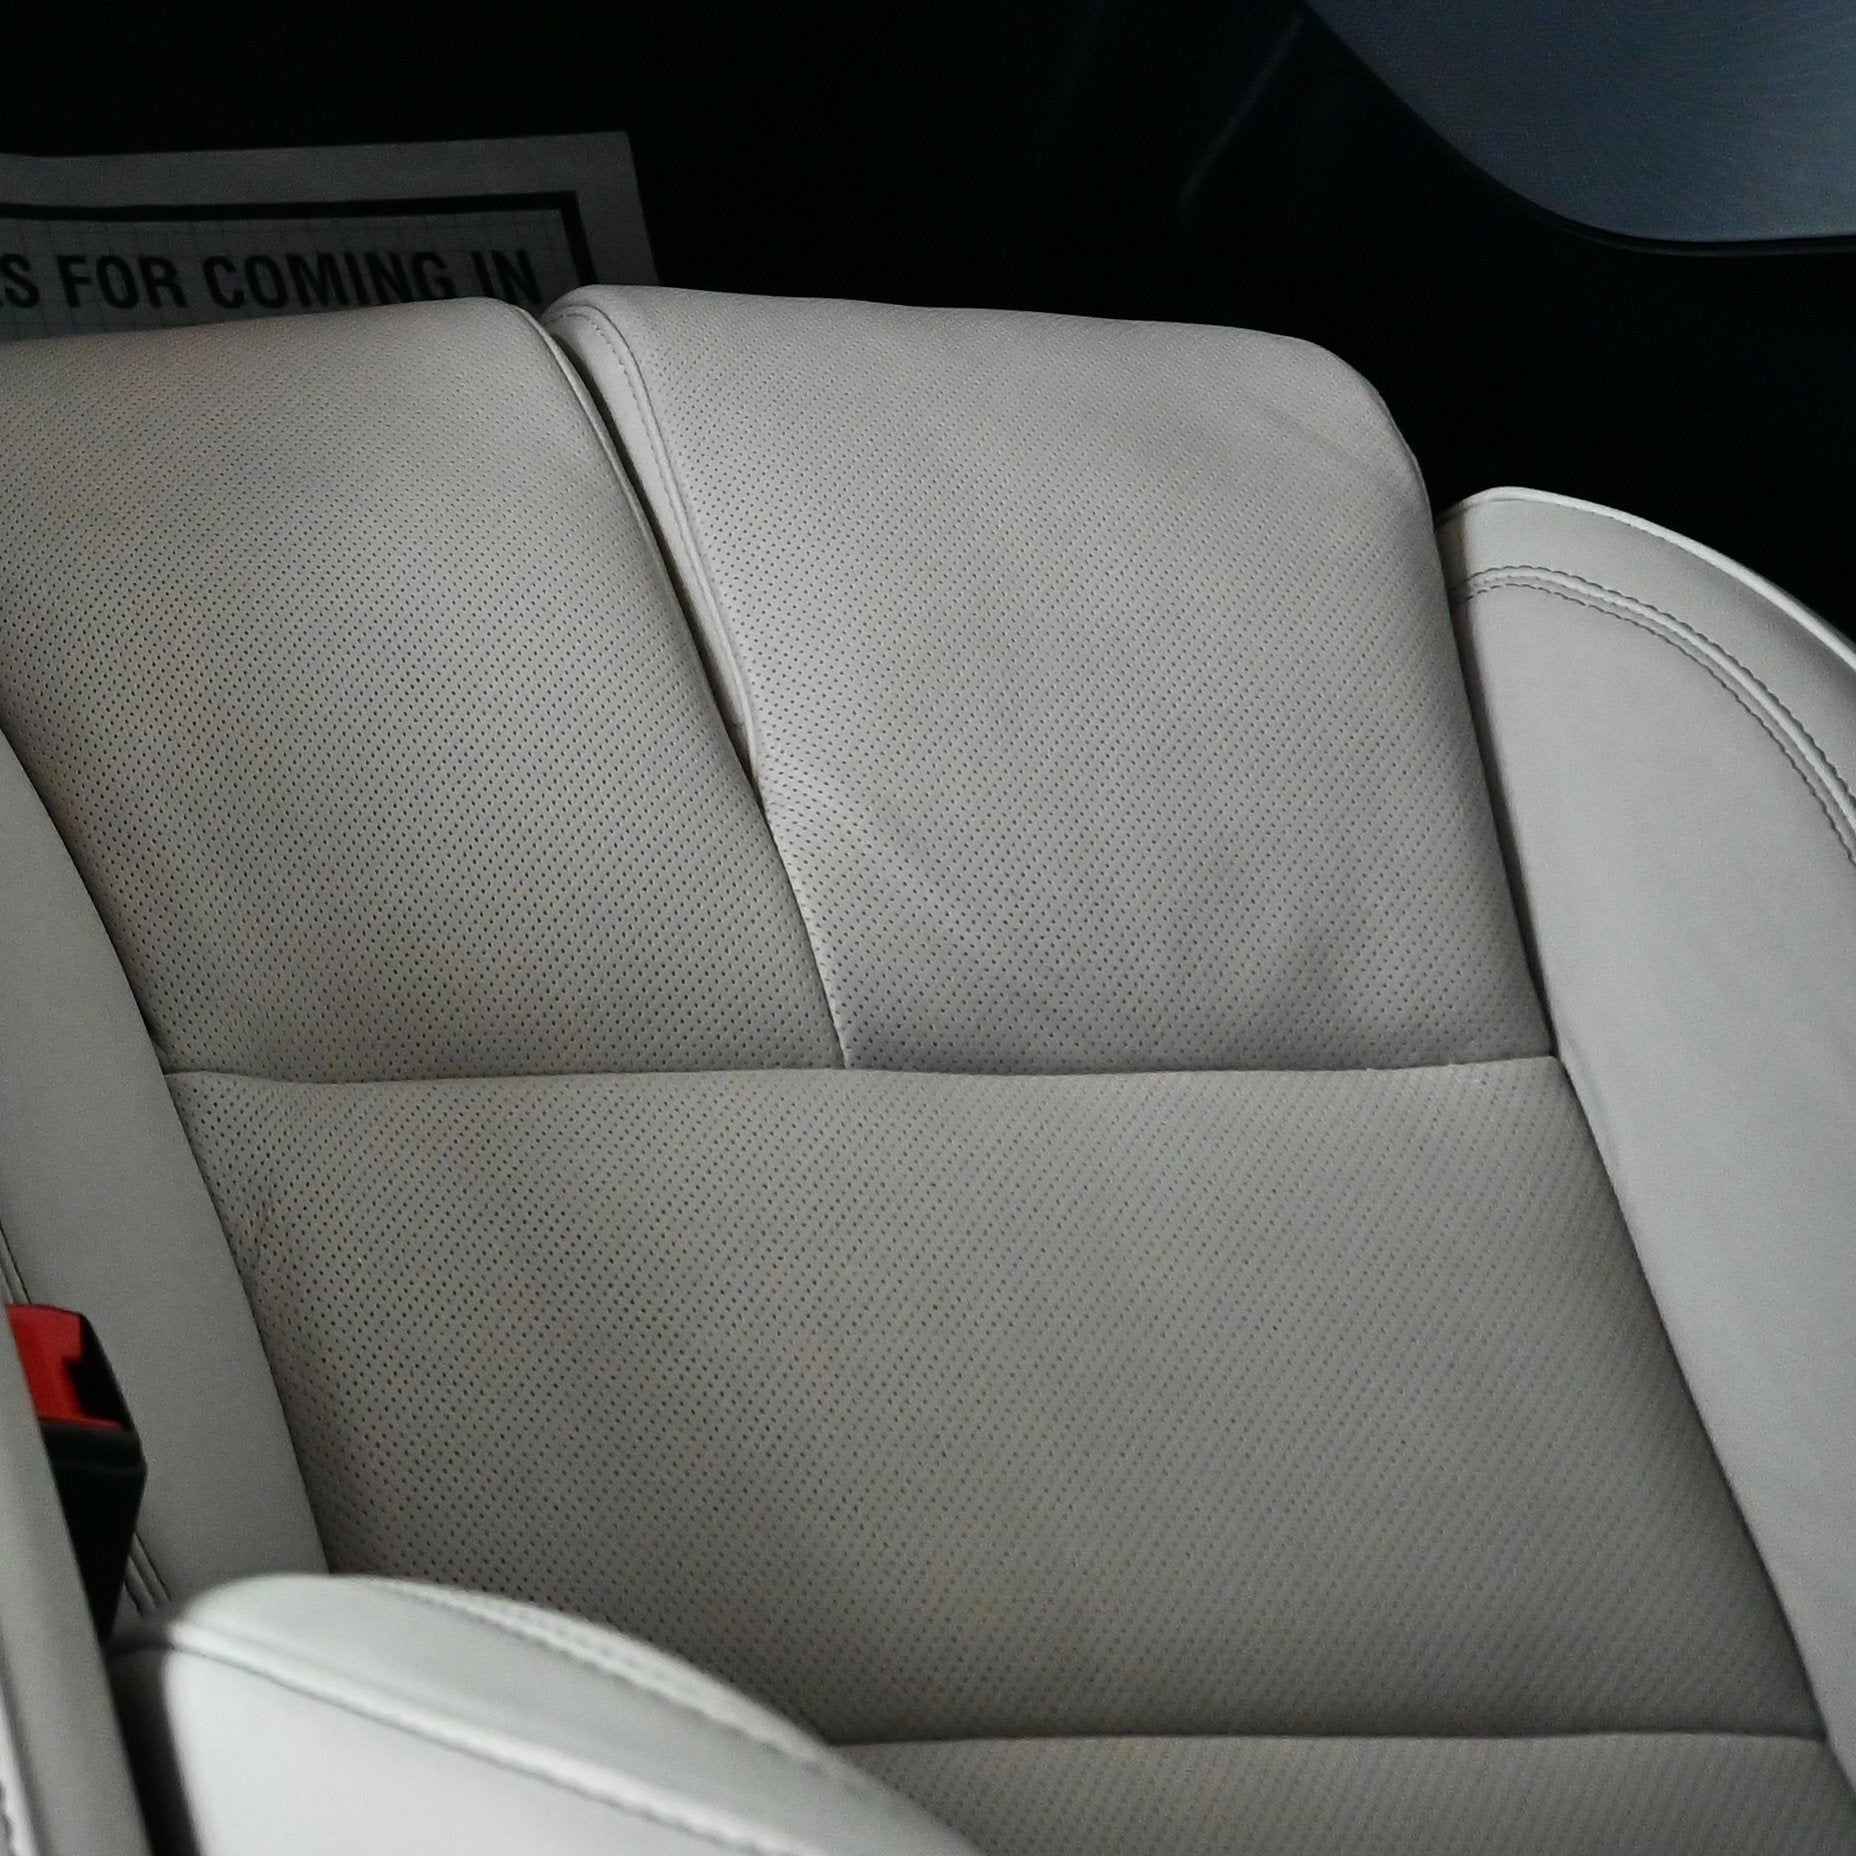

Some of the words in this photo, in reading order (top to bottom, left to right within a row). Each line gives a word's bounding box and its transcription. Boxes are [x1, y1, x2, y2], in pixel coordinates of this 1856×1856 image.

[55, 254, 188, 309] FOR
[202, 251, 456, 309] COMING
[472, 249, 544, 306] IN
